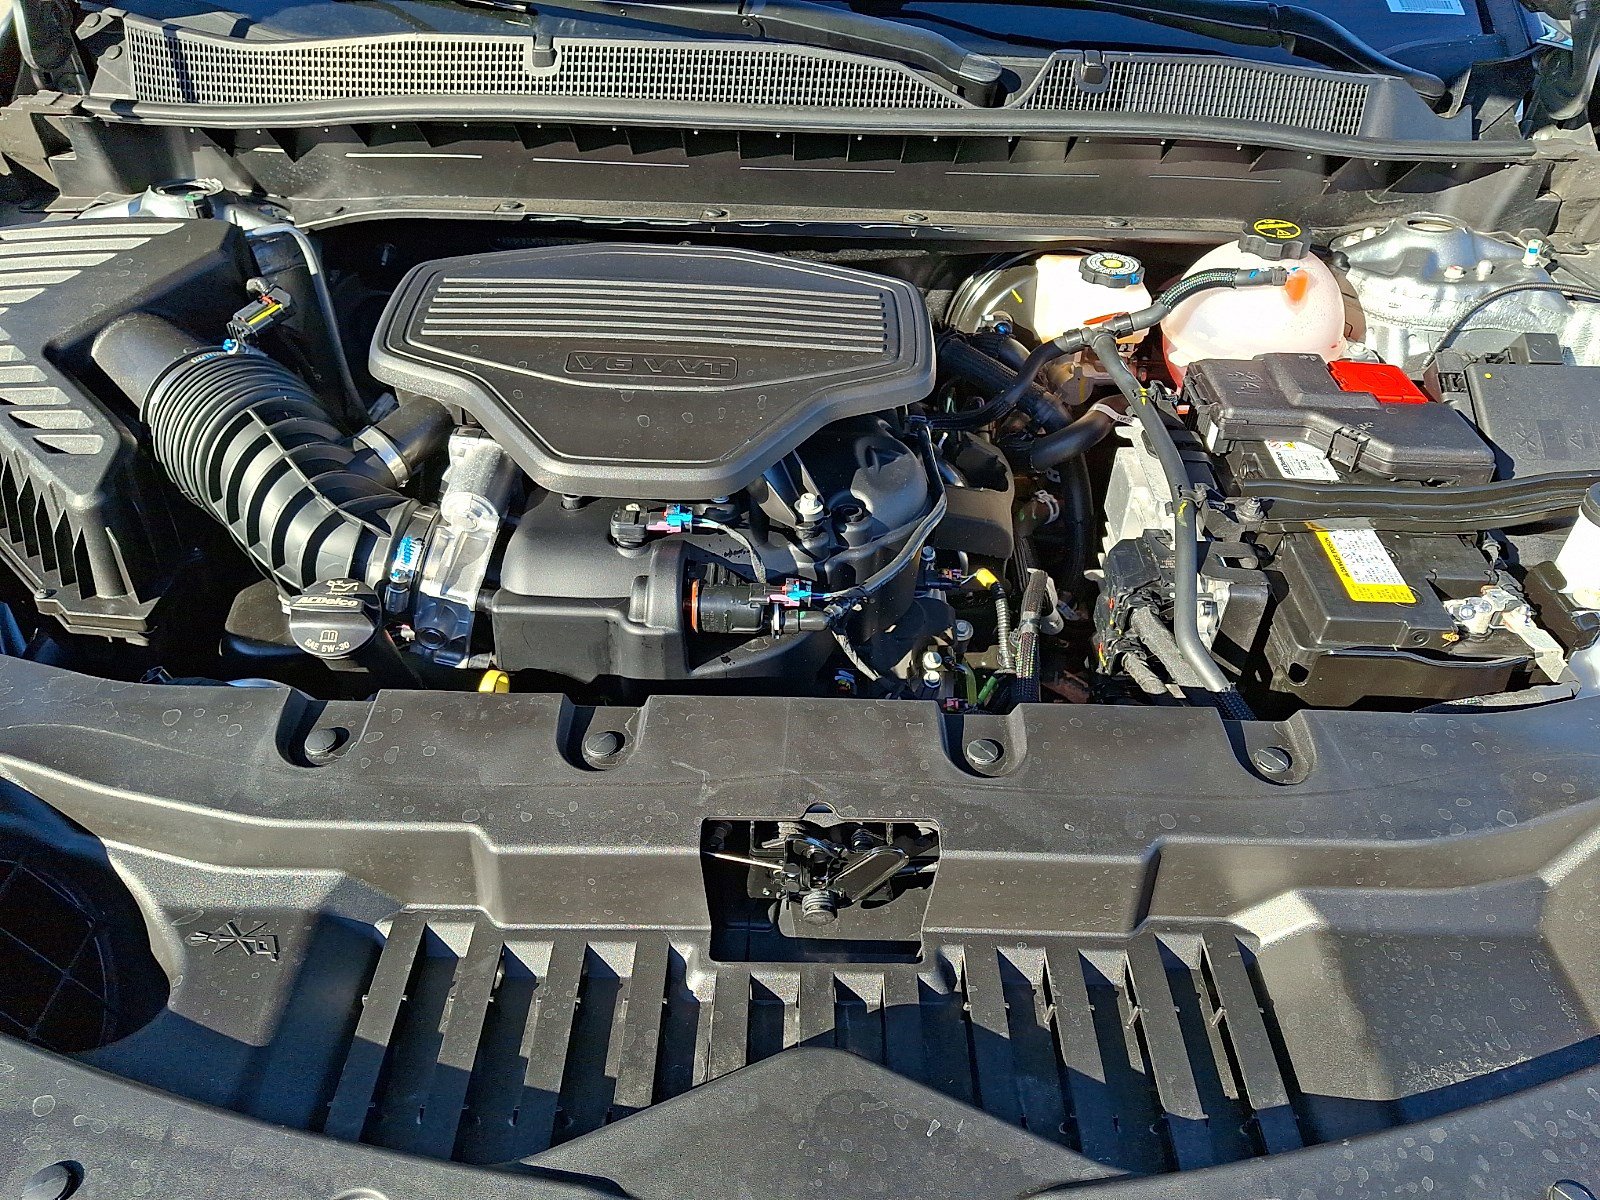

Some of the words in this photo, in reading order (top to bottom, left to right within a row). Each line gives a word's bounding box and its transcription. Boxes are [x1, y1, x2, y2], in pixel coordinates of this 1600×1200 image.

[575, 355, 634, 371] V6
[644, 357, 731, 375] VVT
[298, 596, 359, 606] ACDelco
[304, 638, 319, 651] SAE
[321, 641, 350, 653] 5W-30
